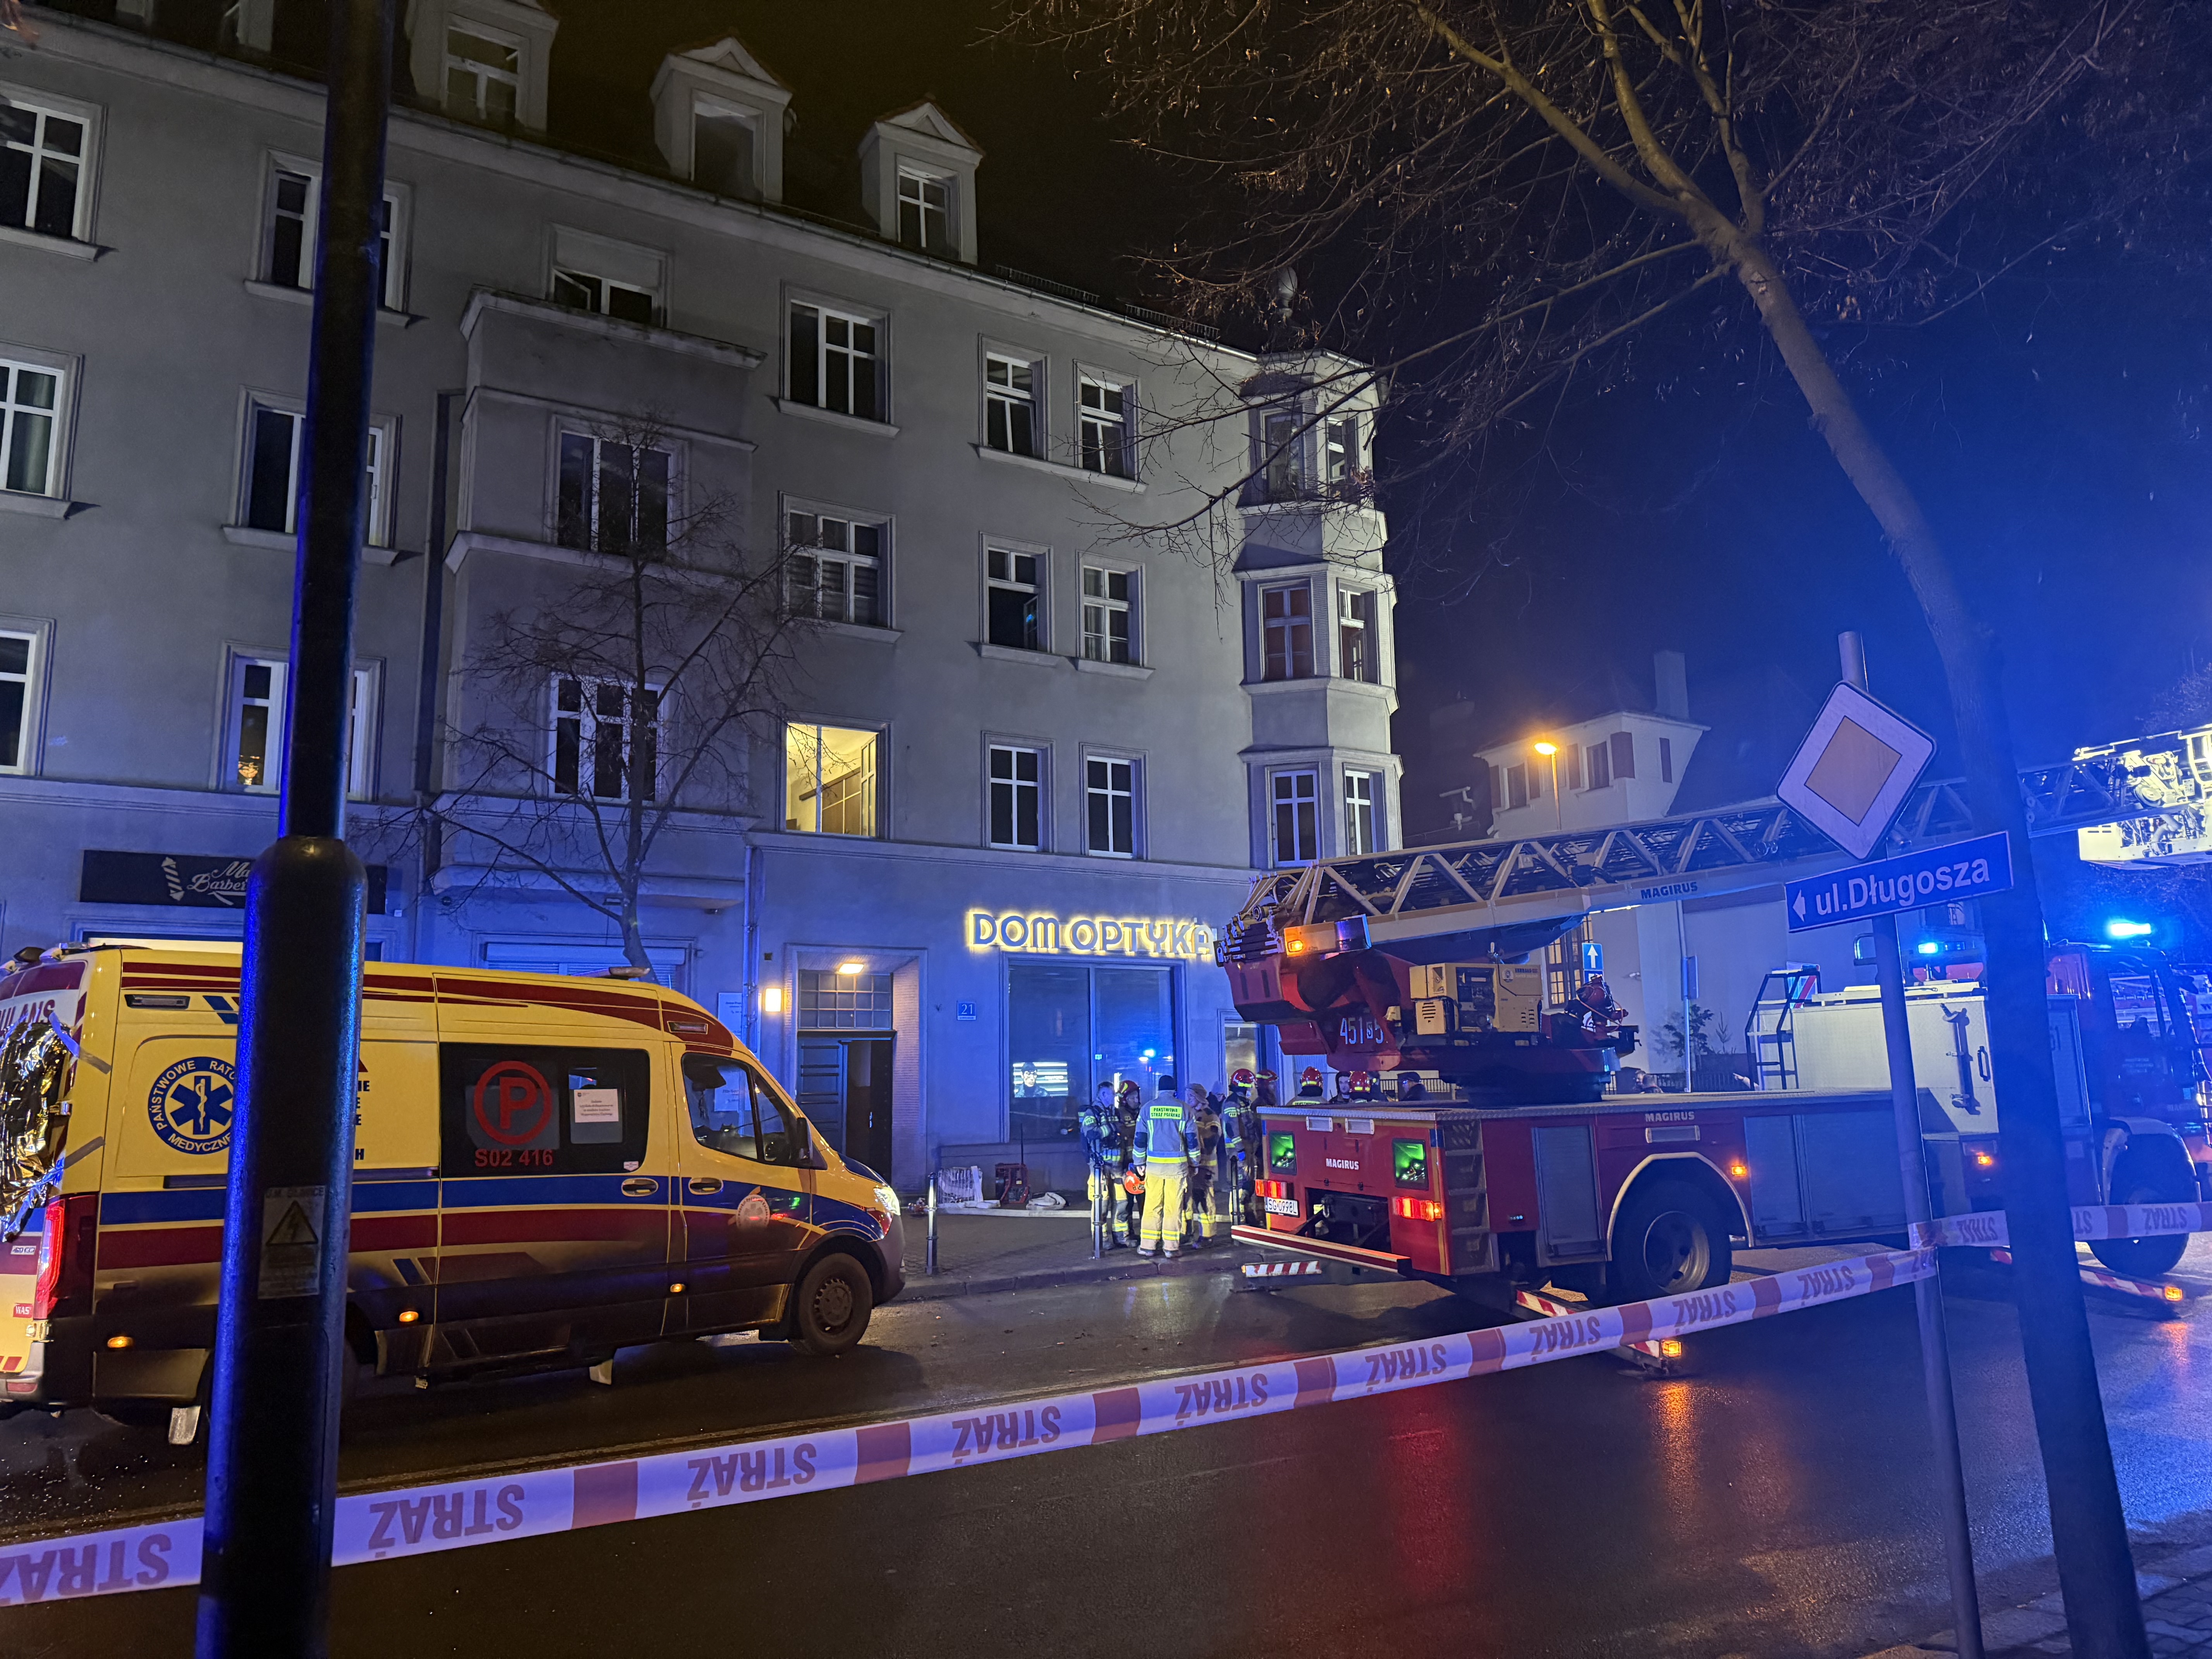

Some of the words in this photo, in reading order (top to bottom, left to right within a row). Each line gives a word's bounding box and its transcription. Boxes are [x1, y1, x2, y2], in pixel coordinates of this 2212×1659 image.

[1640, 882, 1698, 899] MAGIRUS
[1816, 858, 1990, 915] ul.Długosza
[973, 913, 1060, 949] DOM
[1070, 919, 1214, 955] OPTYKA
[962, 1004, 972, 1014] 21
[149, 1060, 196, 1130] PAŃSTWOWE
[1645, 1111, 1695, 1122] MAGIRUS
[475, 1149, 512, 1167] S02
[519, 1149, 553, 1166] 416
[1326, 1158, 1359, 1170] MAGIRUS
[1269, 1199, 1277, 1210] SG
[1279, 1200, 1297, 1214] 0998L
[1797, 1265, 1855, 1306] STRAŻ
[15, 1305, 31, 1315] WAS
[1671, 1291, 1737, 1333] STRAŻ
[1529, 1316, 1601, 1361] STRAŻ
[1364, 1344, 1448, 1392] STRAŻ
[1175, 1373, 1268, 1427] STRAŻ
[952, 1406, 1061, 1465] STRAŻ
[686, 1442, 816, 1508] STRAŻ
[369, 1484, 525, 1558] STRAŻ
